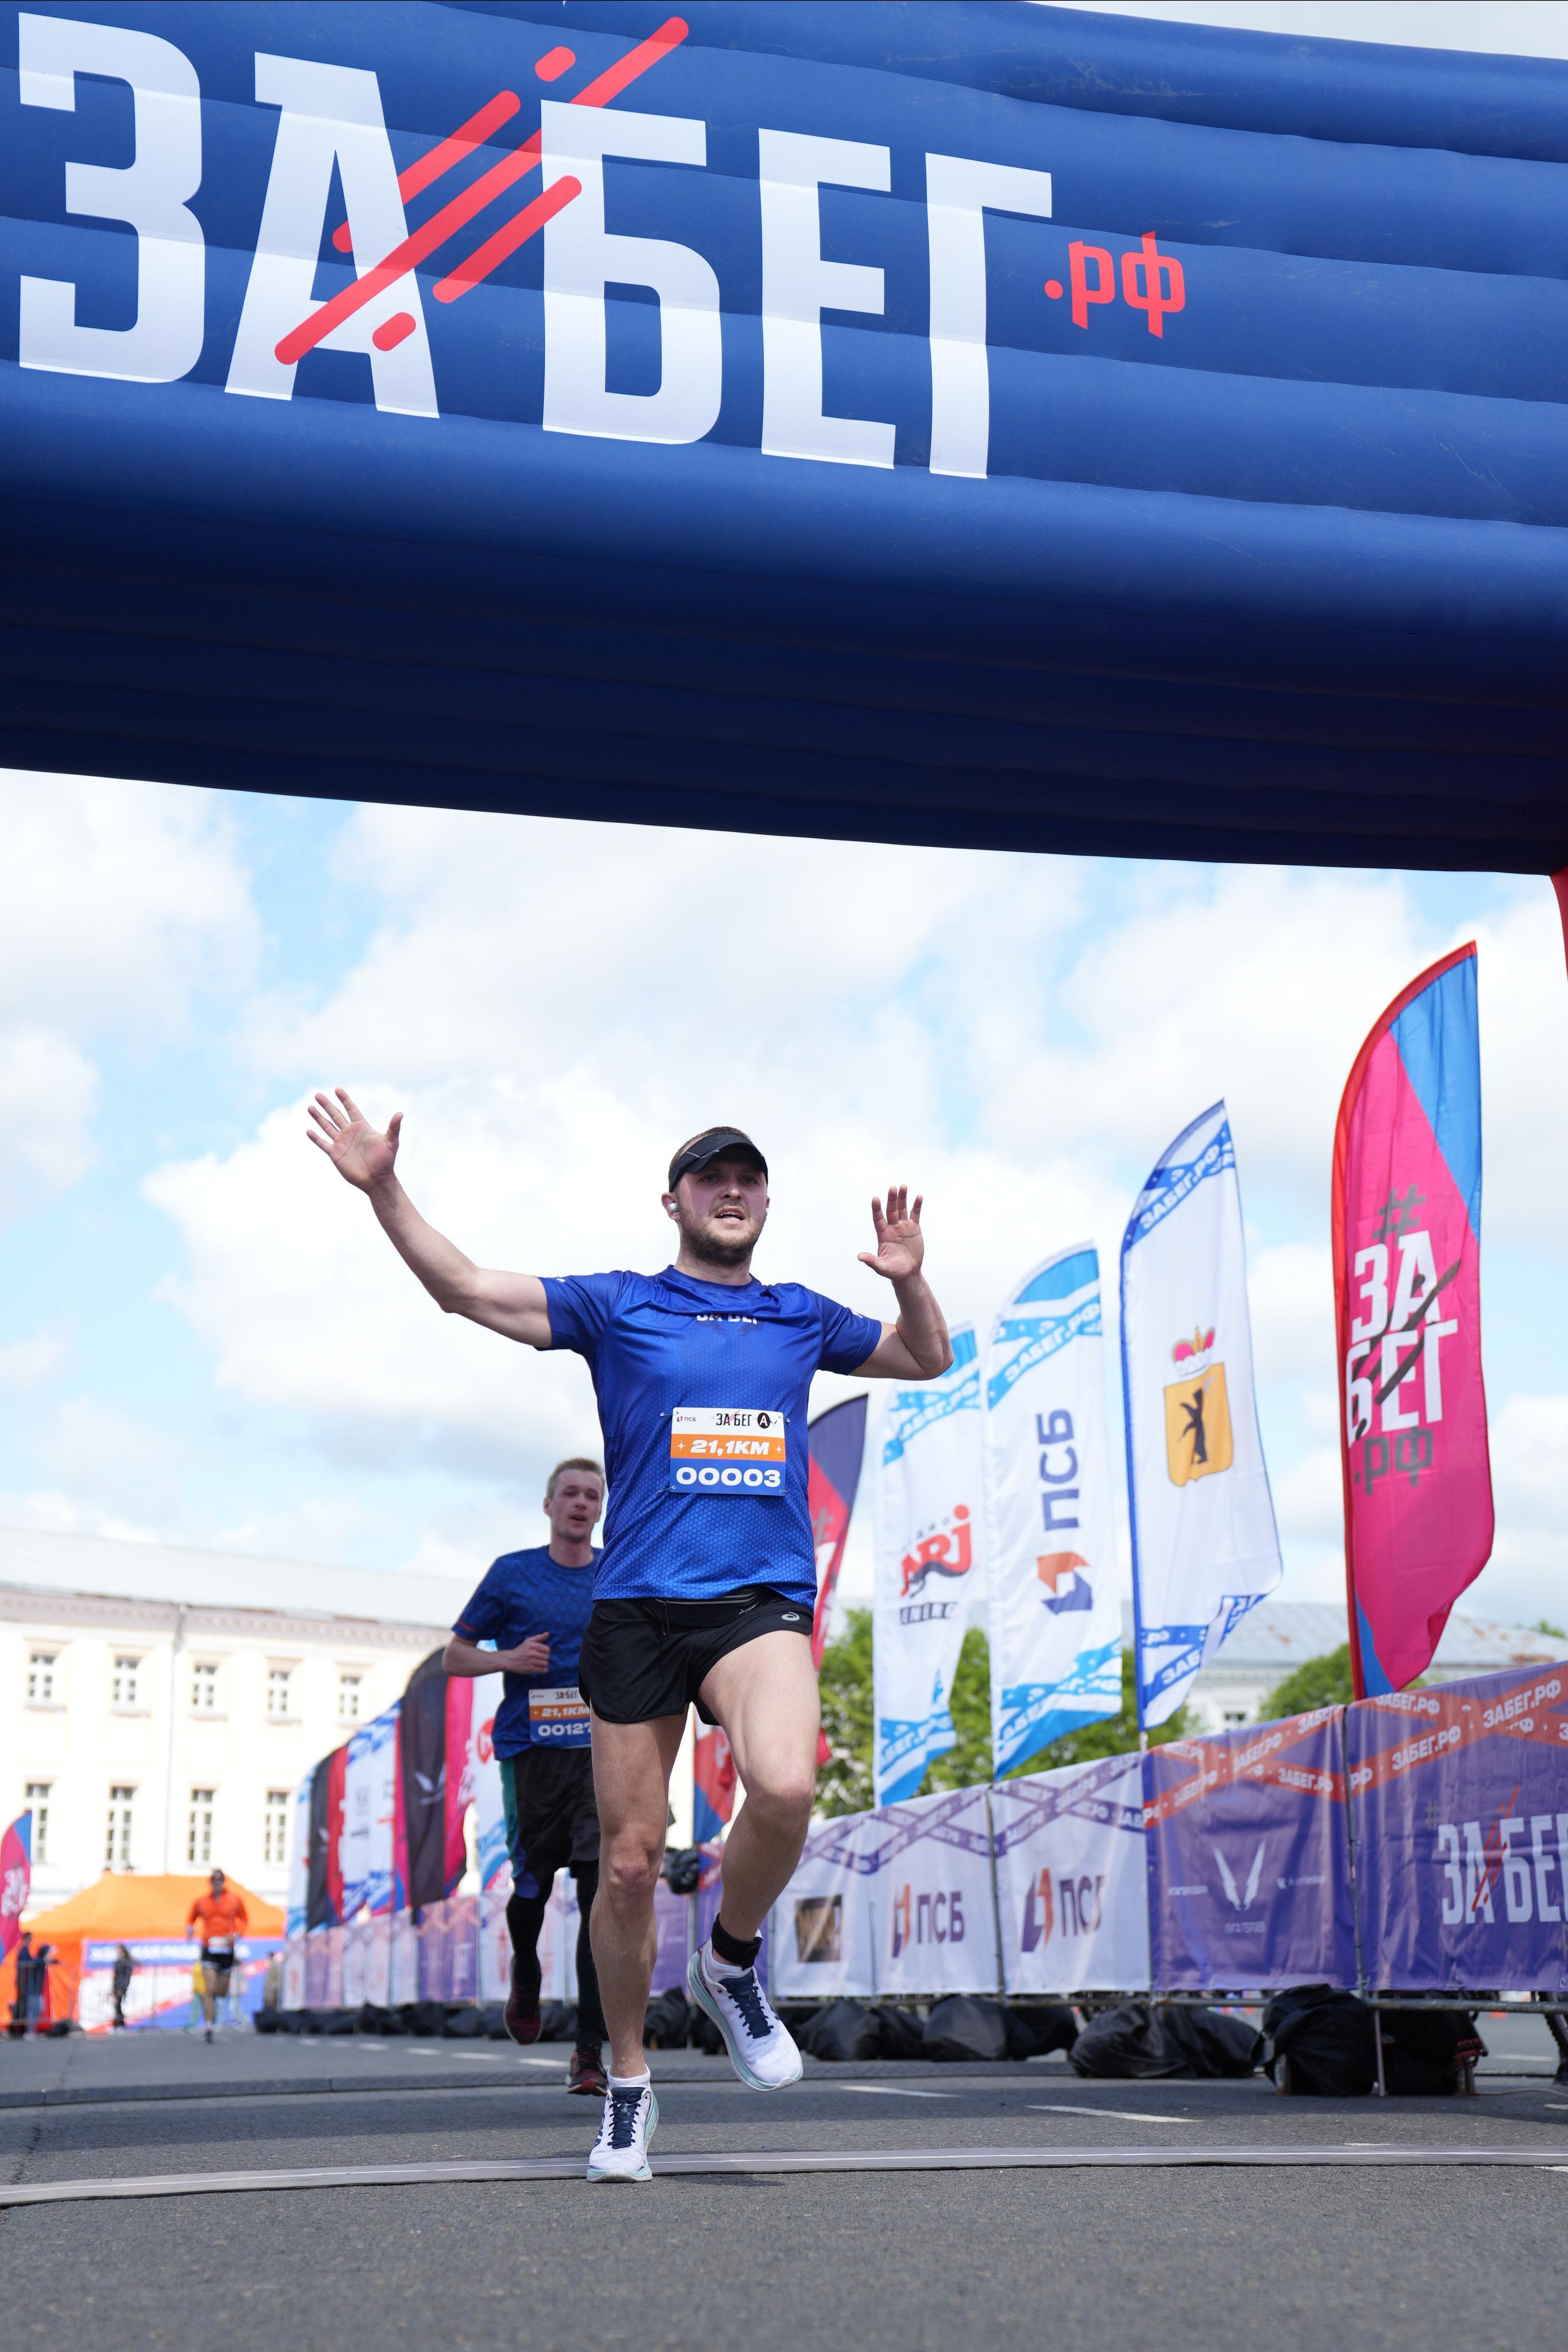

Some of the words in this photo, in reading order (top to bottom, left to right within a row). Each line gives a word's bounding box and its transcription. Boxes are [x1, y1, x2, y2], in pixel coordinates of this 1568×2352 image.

[676, 1467, 781, 1488] 00003
[1036, 1409, 1079, 1531] ПСБ
[1483, 1678, 1561, 1728] ЗАБЕГ.РФ
[1392, 1725, 1461, 1770] ЗАБЕГ.РФ
[916, 1890, 965, 1945] ПСБ
